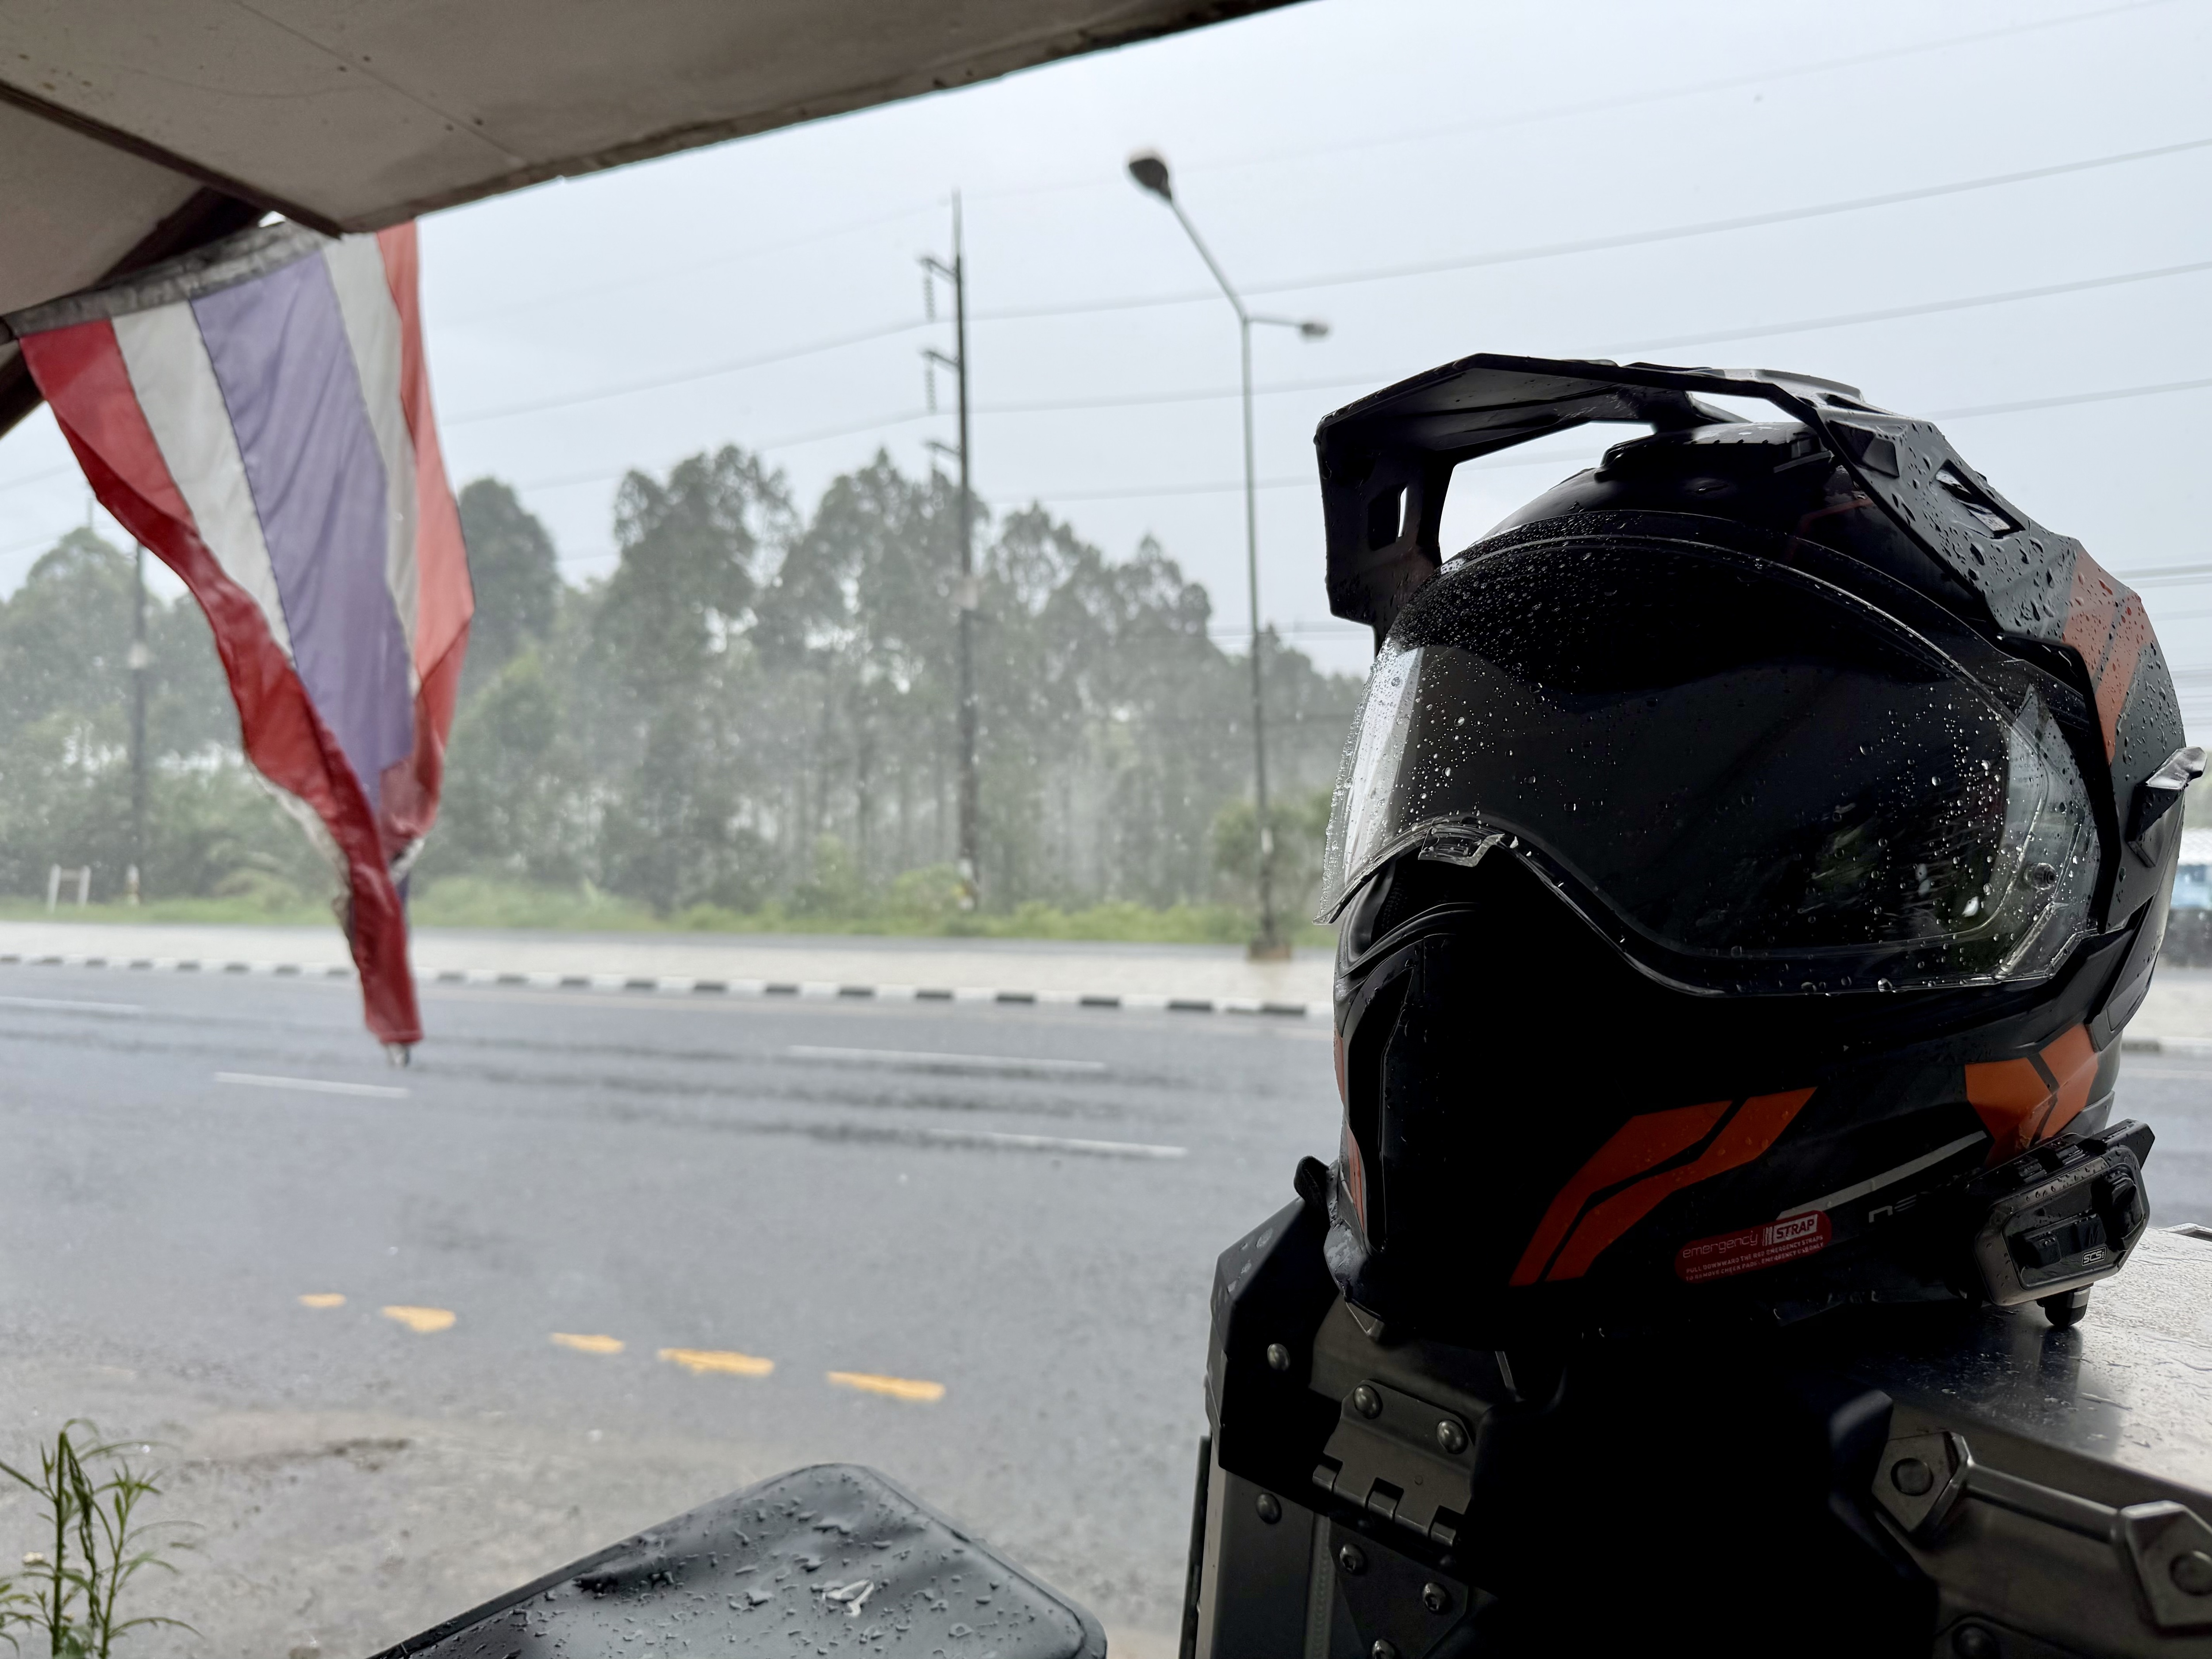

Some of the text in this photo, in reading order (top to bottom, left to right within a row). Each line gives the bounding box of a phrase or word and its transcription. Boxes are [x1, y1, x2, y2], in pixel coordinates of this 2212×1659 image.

[1683, 1219, 1814, 1258] emergency STRAP
[1703, 1257, 1740, 1271] DOWNWARD
[1740, 1253, 1751, 1262] THE
[1766, 1241, 1801, 1255] EMERGENCY
[1801, 1235, 1823, 1246] STRAPS
[2083, 1250, 2102, 1264] SCS
[1720, 1264, 1741, 1274] CHEEK
